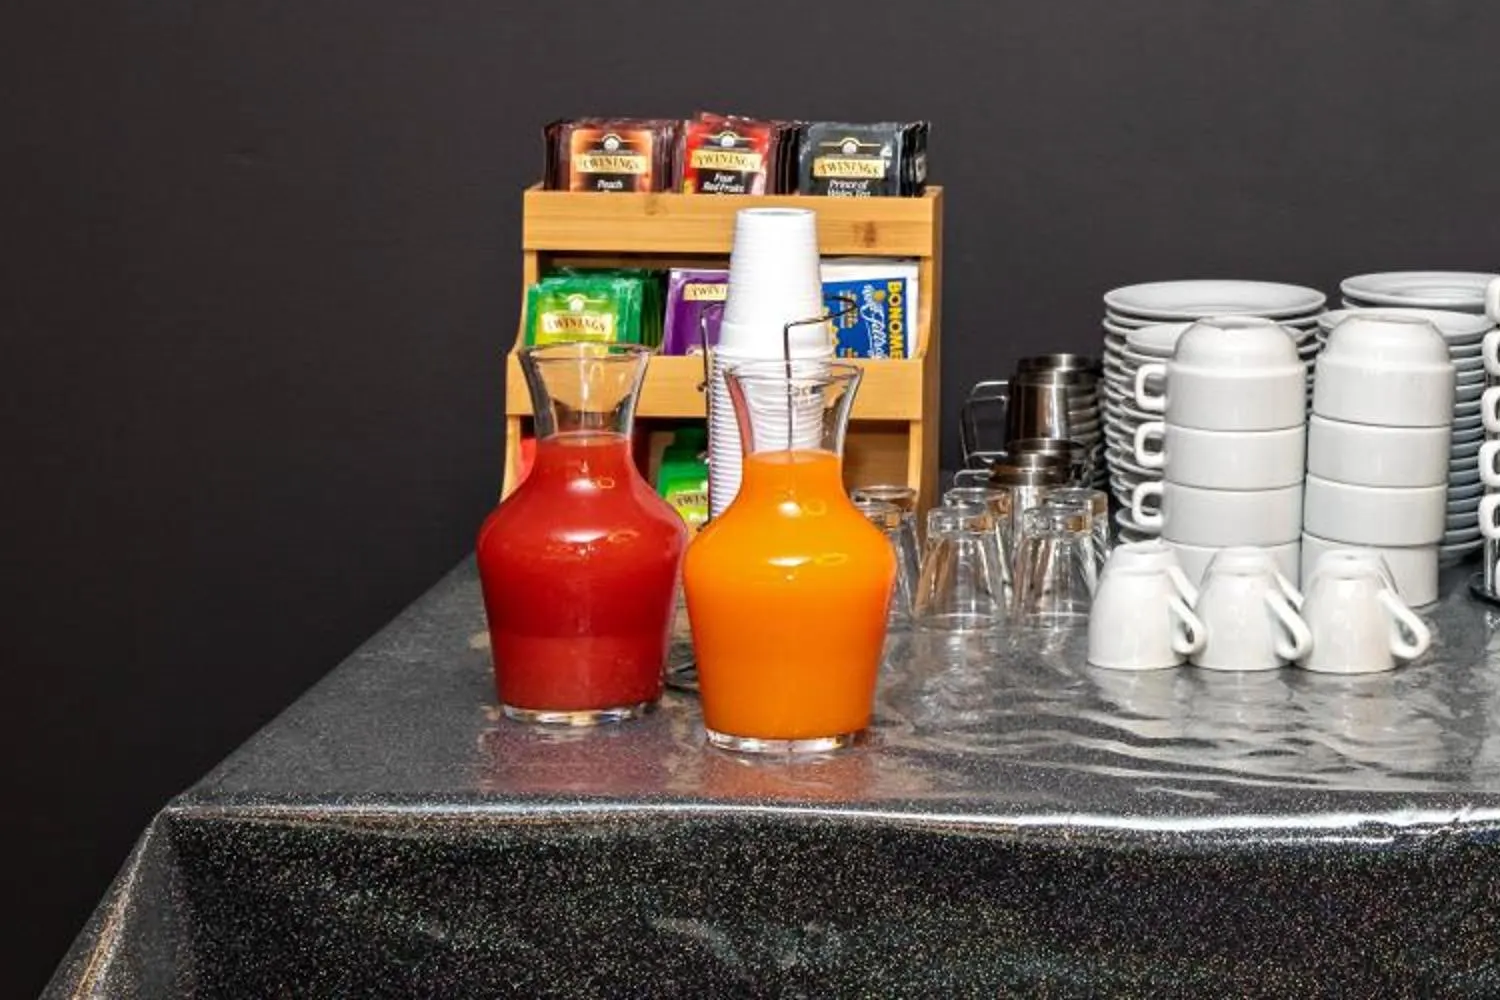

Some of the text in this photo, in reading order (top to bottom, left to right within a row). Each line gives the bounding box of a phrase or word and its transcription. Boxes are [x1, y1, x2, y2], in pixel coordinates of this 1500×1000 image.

[579, 155, 640, 170] TWININGS
[694, 152, 756, 169] TWININGS
[816, 159, 880, 175] TWININGS
[597, 179, 623, 190] Peach
[713, 172, 735, 183] Four
[829, 179, 857, 190] Prince
[703, 181, 745, 193] Red Fruits
[547, 315, 606, 333] TWININGS
[887, 281, 904, 359] BONOME
